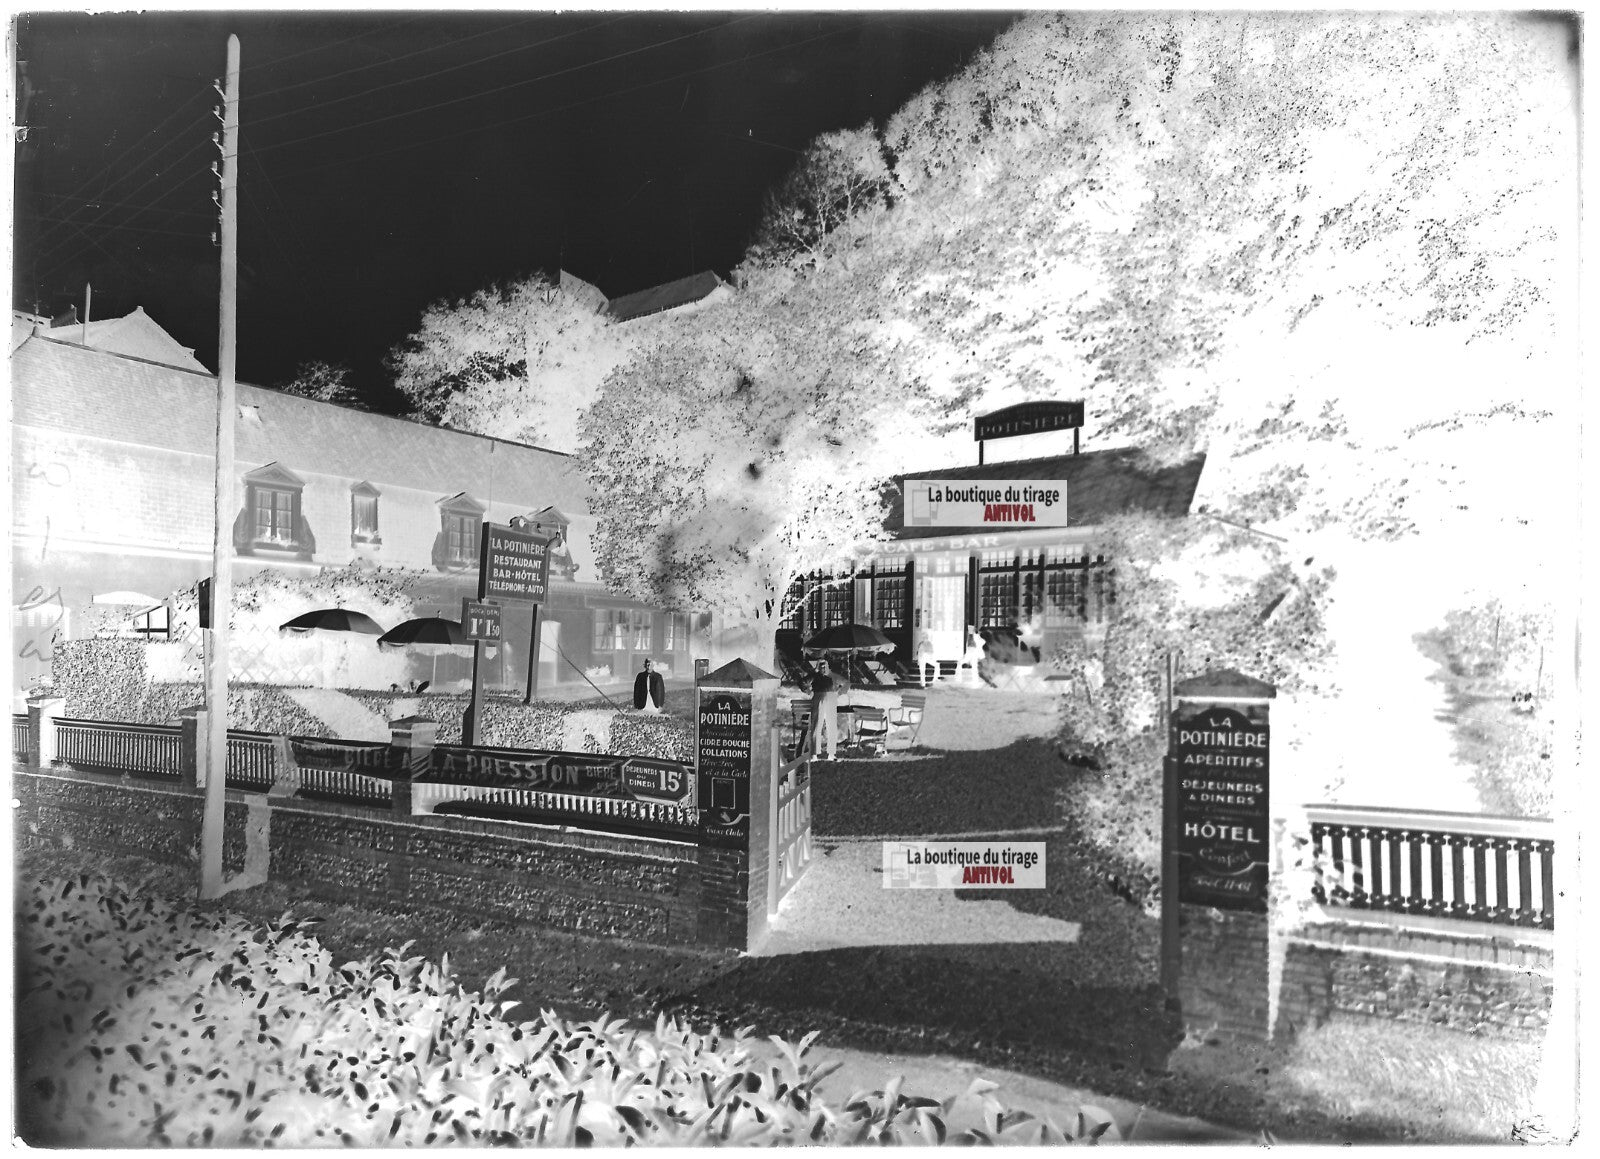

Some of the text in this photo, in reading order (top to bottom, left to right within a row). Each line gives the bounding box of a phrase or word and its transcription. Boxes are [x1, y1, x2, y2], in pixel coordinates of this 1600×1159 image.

[491, 538, 503, 550] LA
[949, 536, 1000, 550] BAR
[494, 555, 542, 569] RESTAURANT
[717, 702, 731, 711] LA
[1209, 717, 1232, 728] LA
[700, 738, 721, 747] CIDRE
[701, 748, 748, 759] COLLATIONS
[467, 754, 579, 785] PRESSION
[1185, 820, 1260, 843] HÔTEL
